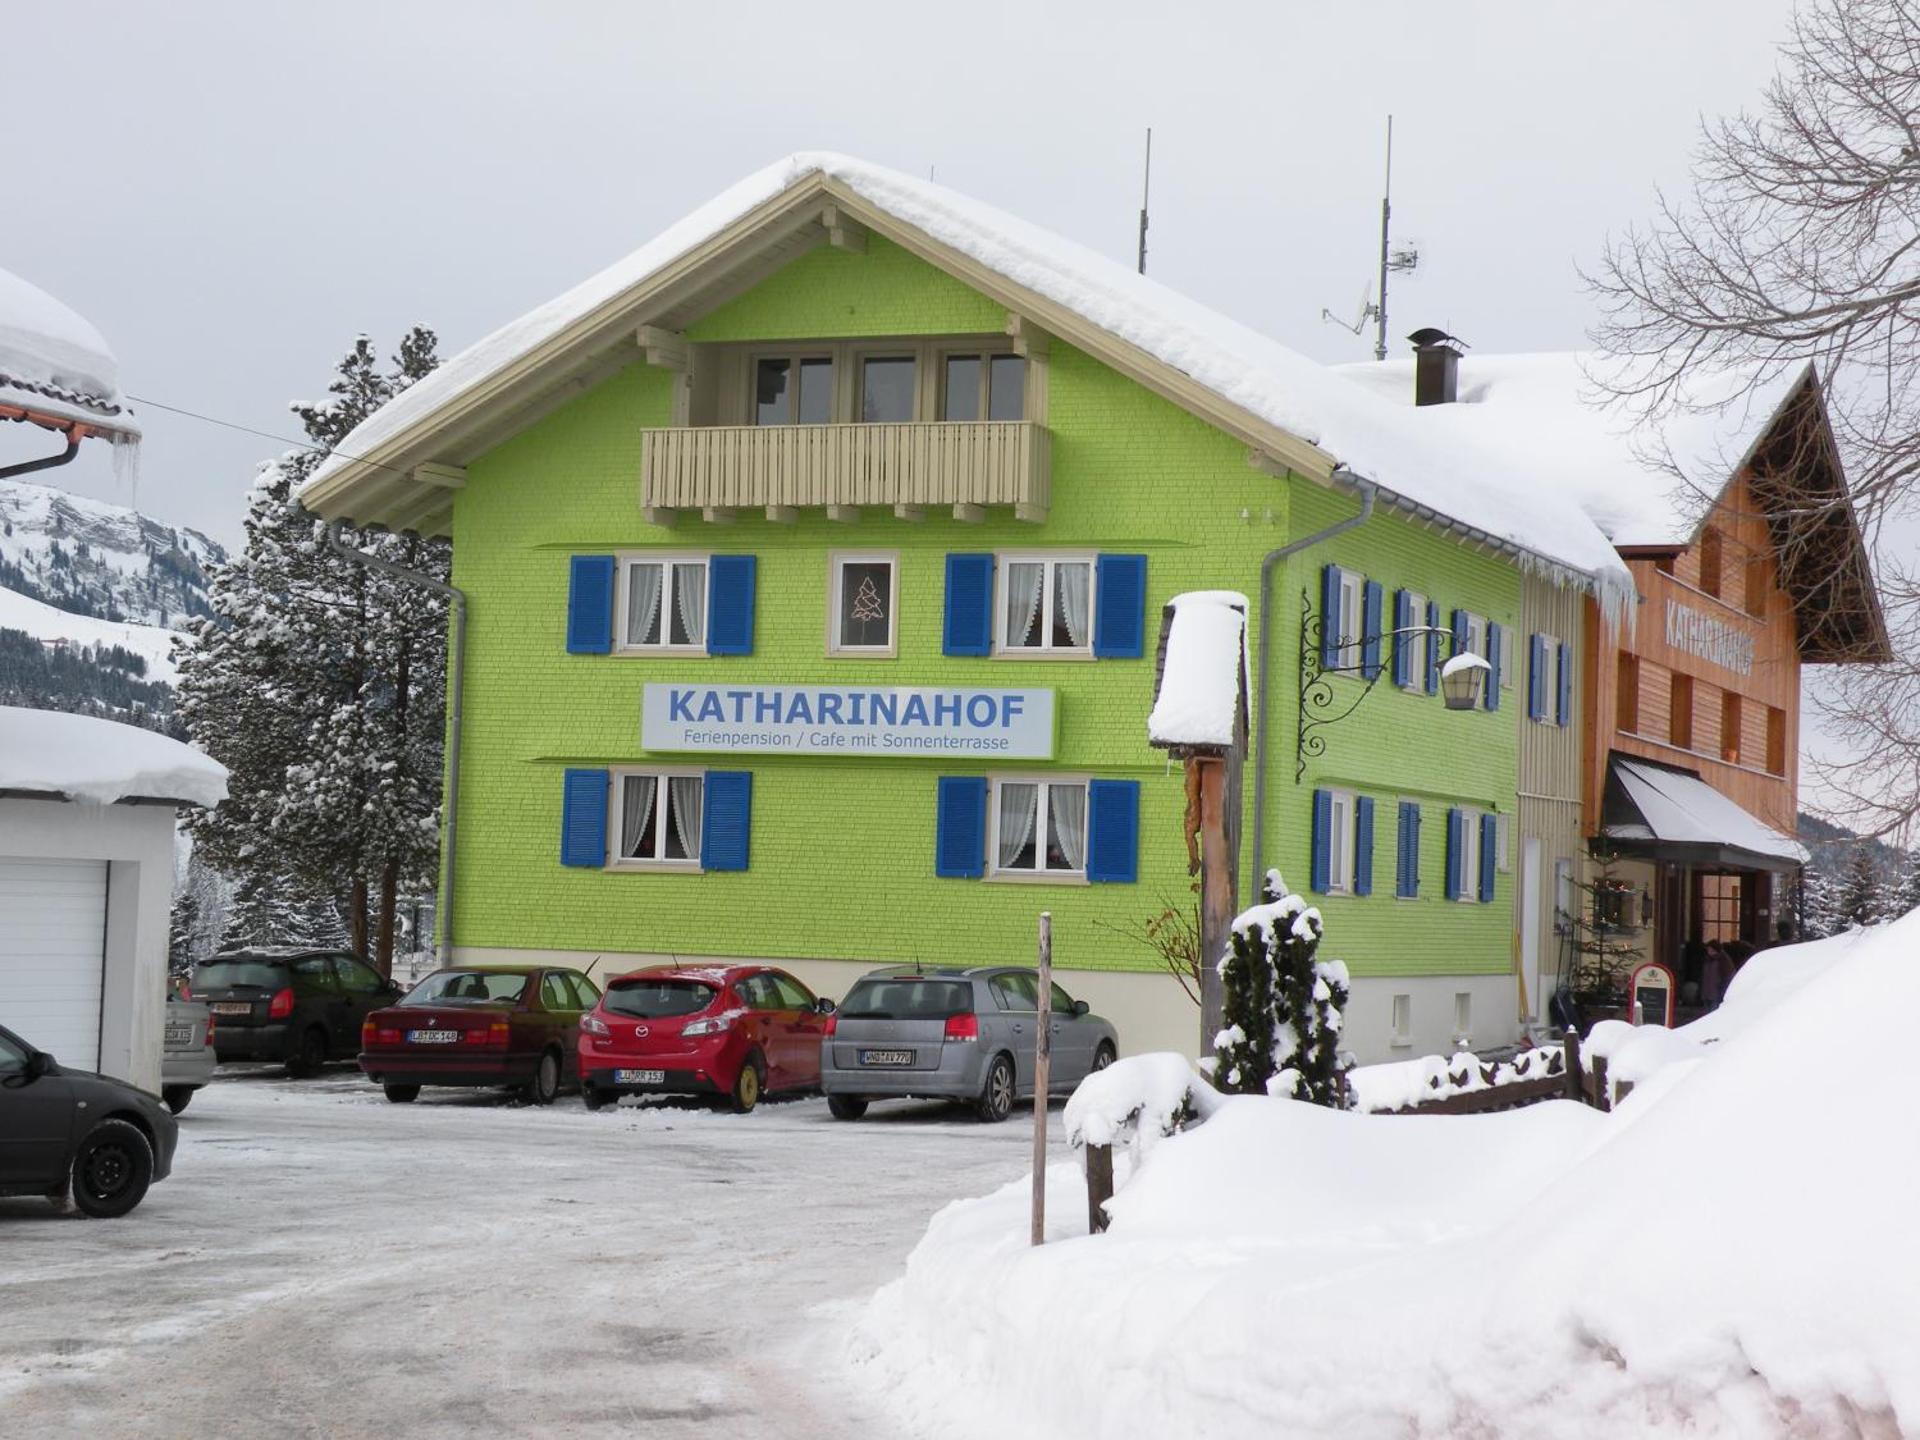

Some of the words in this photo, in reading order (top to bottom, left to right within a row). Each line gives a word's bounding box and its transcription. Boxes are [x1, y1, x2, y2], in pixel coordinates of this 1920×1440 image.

[669, 689, 1025, 728] KATHARINAHOF
[684, 729, 791, 747] Ferienpension
[810, 732, 845, 747] Cafe
[851, 733, 877, 748] mit
[883, 733, 1009, 750] Sonnenterrasse
